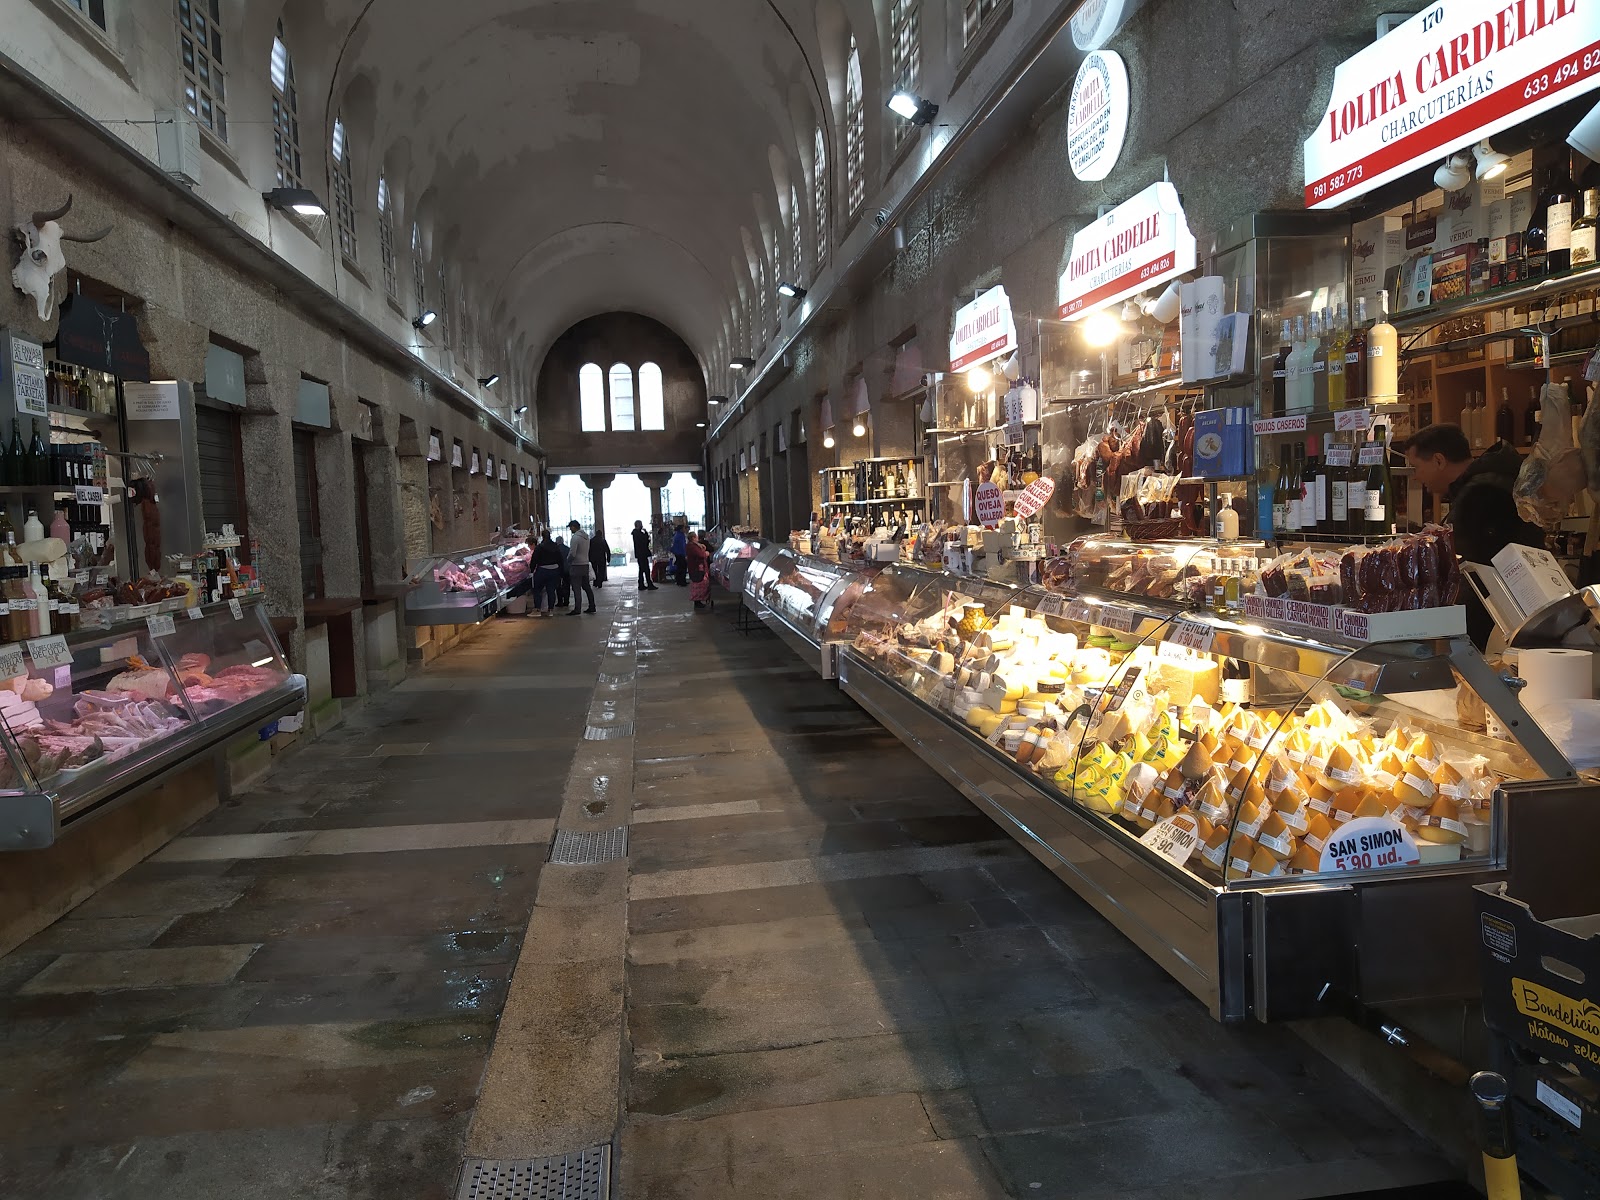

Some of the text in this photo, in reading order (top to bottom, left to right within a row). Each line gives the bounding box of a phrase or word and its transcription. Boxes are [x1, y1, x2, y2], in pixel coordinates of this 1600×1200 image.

[1422, 7, 1444, 33] 170
[1523, 49, 1600, 100] 633 494 82
[1079, 76, 1100, 106] LOLITA
[1075, 88, 1105, 127] CARDELLE
[1329, 70, 1408, 144] LOLITA
[1381, 70, 1495, 144] CHARCUTERÍAS
[1069, 114, 1104, 149] ESPECIALIDAD
[1070, 137, 1089, 161] CARNES
[1089, 131, 1099, 147] DEL
[1078, 138, 1106, 168] EMBUTIDOS
[1313, 164, 1364, 199] 981 582 773
[1449, 229, 1473, 242] VERMU
[1070, 211, 1160, 281] LOLITA CARDELLE
[1140, 267, 1150, 279] 633
[1160, 257, 1169, 270] 826
[14, 343, 42, 356] SE ENVASA
[14, 352, 23, 360] AL
[16, 373, 44, 389] ACEPTAMOS
[17, 385, 45, 400] TARJETAS
[1254, 418, 1305, 433] ORUJOS CASEROS
[1026, 484, 1049, 502] GALLEGO
[1033, 478, 1053, 493] QUESO
[977, 488, 1000, 501] QUESO
[1019, 493, 1042, 510] CURADO
[978, 500, 1001, 511] OVEJA
[1014, 502, 1022, 510] EN
[979, 510, 1003, 522] GALLEGO
[1505, 563, 1523, 579] VERMU
[1245, 596, 1262, 607] CHORIZO
[1264, 598, 1283, 609] CHORIZO
[1286, 601, 1308, 614] CERDO
[1265, 608, 1284, 620] GALLEGO
[1308, 604, 1328, 617] CHORIZO
[1308, 615, 1329, 629] PICANTE
[1344, 613, 1368, 628] CHORIZO
[1344, 625, 1369, 640] GALLEGO
[0, 656, 22, 669] OTELLAS
[32, 652, 47, 660] DEL
[1159, 822, 1195, 849] SAN SIMON
[1329, 828, 1403, 858] SAN SIMON
[1377, 847, 1402, 866] ud.
[1528, 1020, 1569, 1047] plátano
